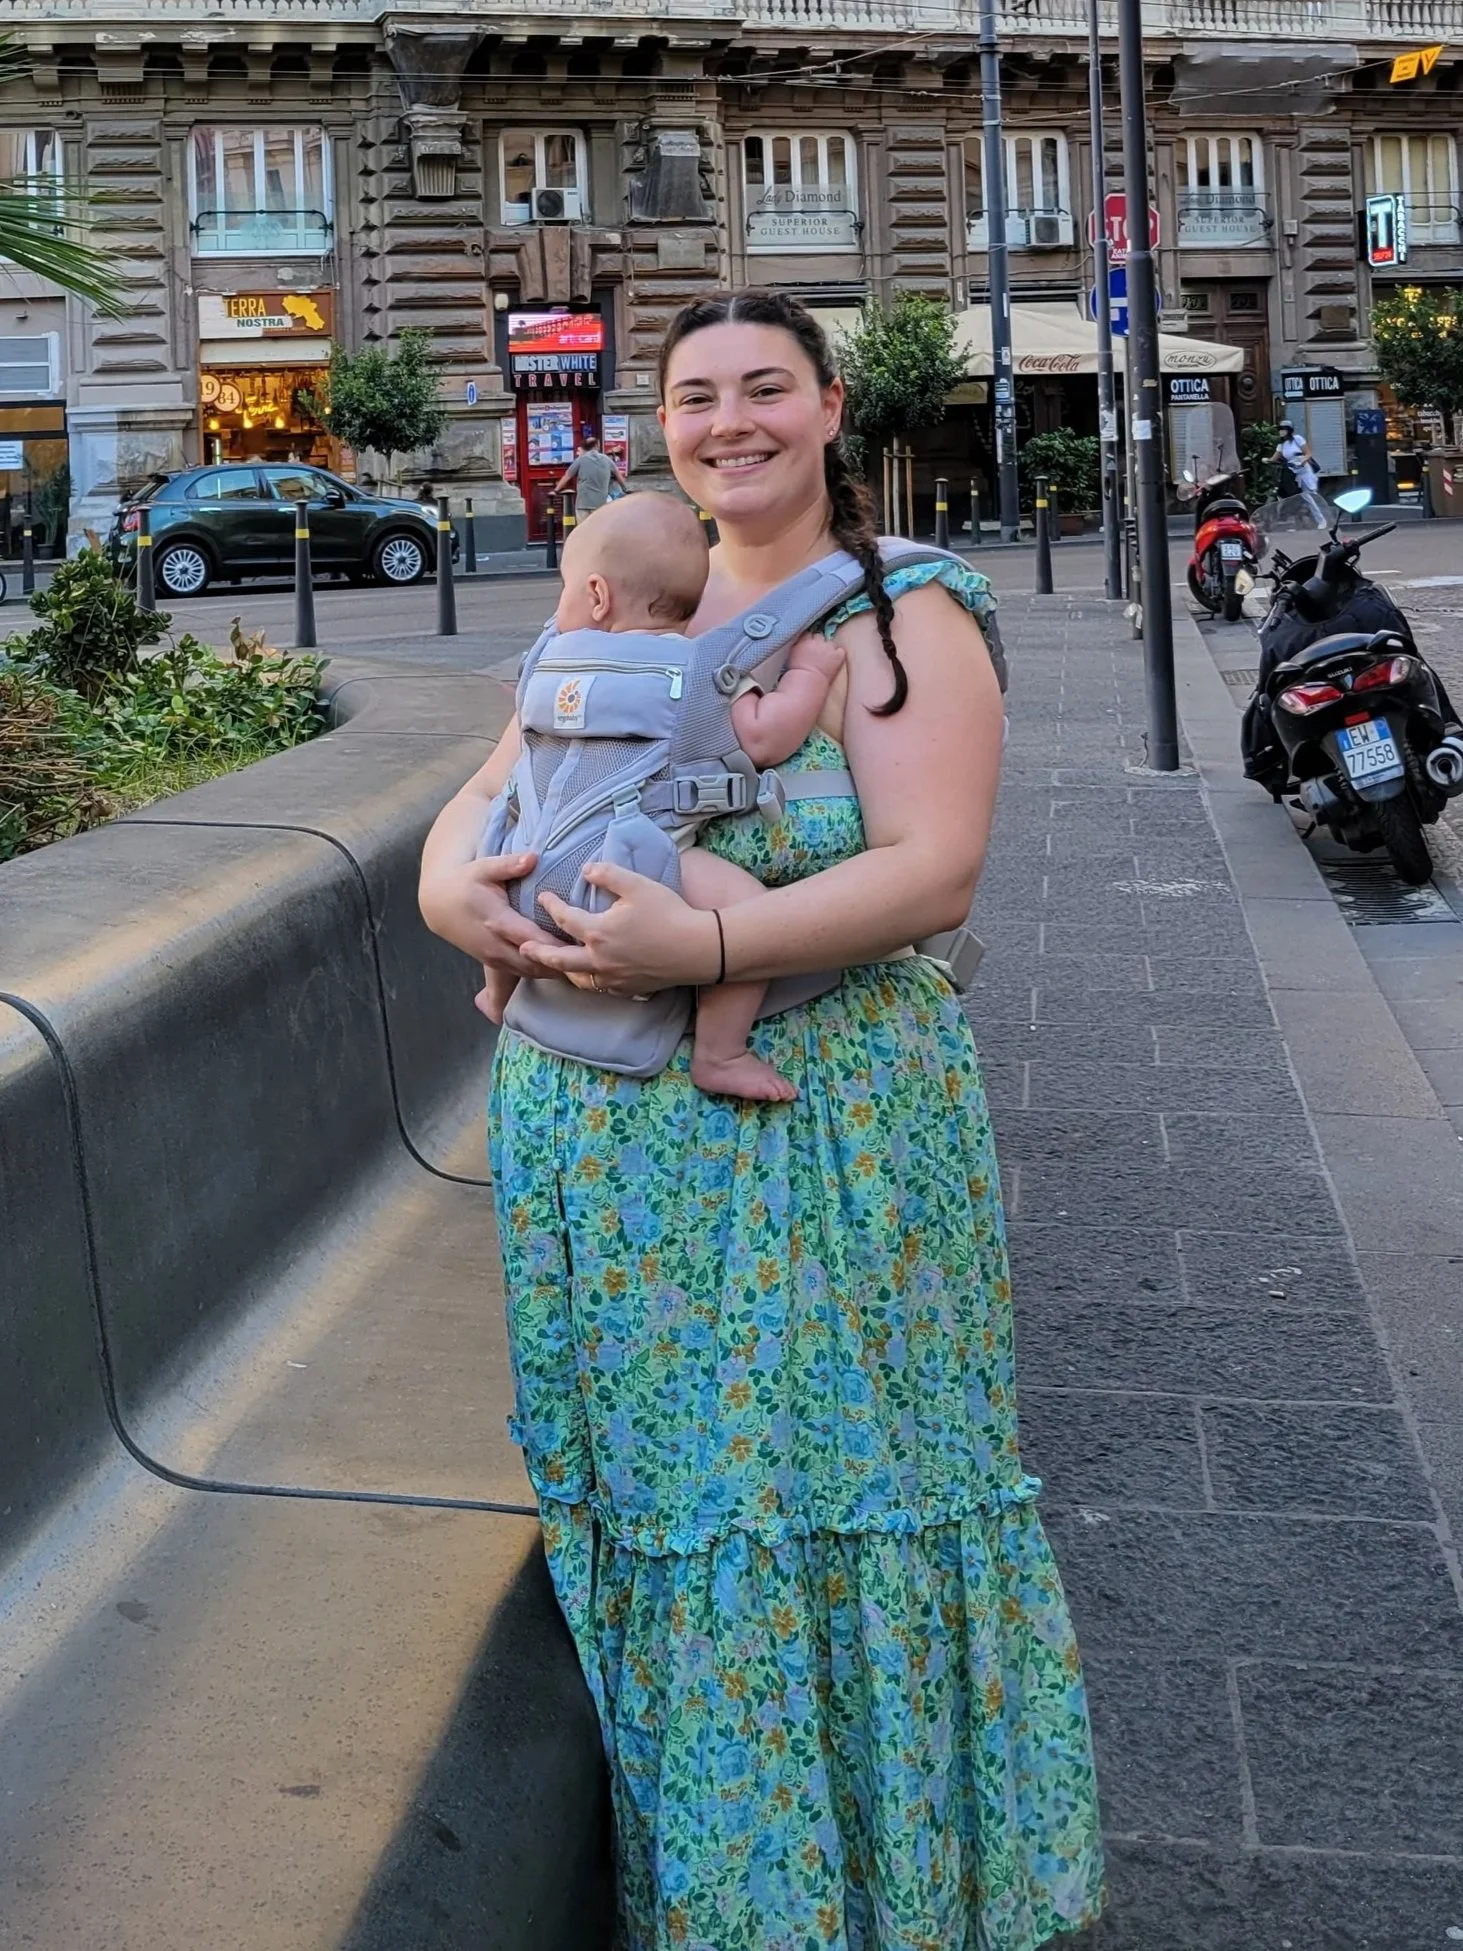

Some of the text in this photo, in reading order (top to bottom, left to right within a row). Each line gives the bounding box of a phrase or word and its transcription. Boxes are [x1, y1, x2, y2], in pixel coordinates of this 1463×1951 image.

[785, 190, 842, 202] Diamond
[772, 218, 828, 226] SUPERIOR
[1185, 225, 1257, 233] GUEST HOUSE
[1396, 195, 1407, 261] TABACCHI
[760, 226, 841, 236] GUEST HOUSE
[223, 298, 267, 318] TERRA
[237, 318, 285, 328] NOSTRA
[560, 355, 597, 371] WHITE
[513, 372, 597, 388] TRAVEL
[1170, 378, 1210, 393] OTTICA
[1309, 376, 1340, 391] OTTICA
[1348, 724, 1370, 747] EW
[1347, 743, 1396, 774] 77558
